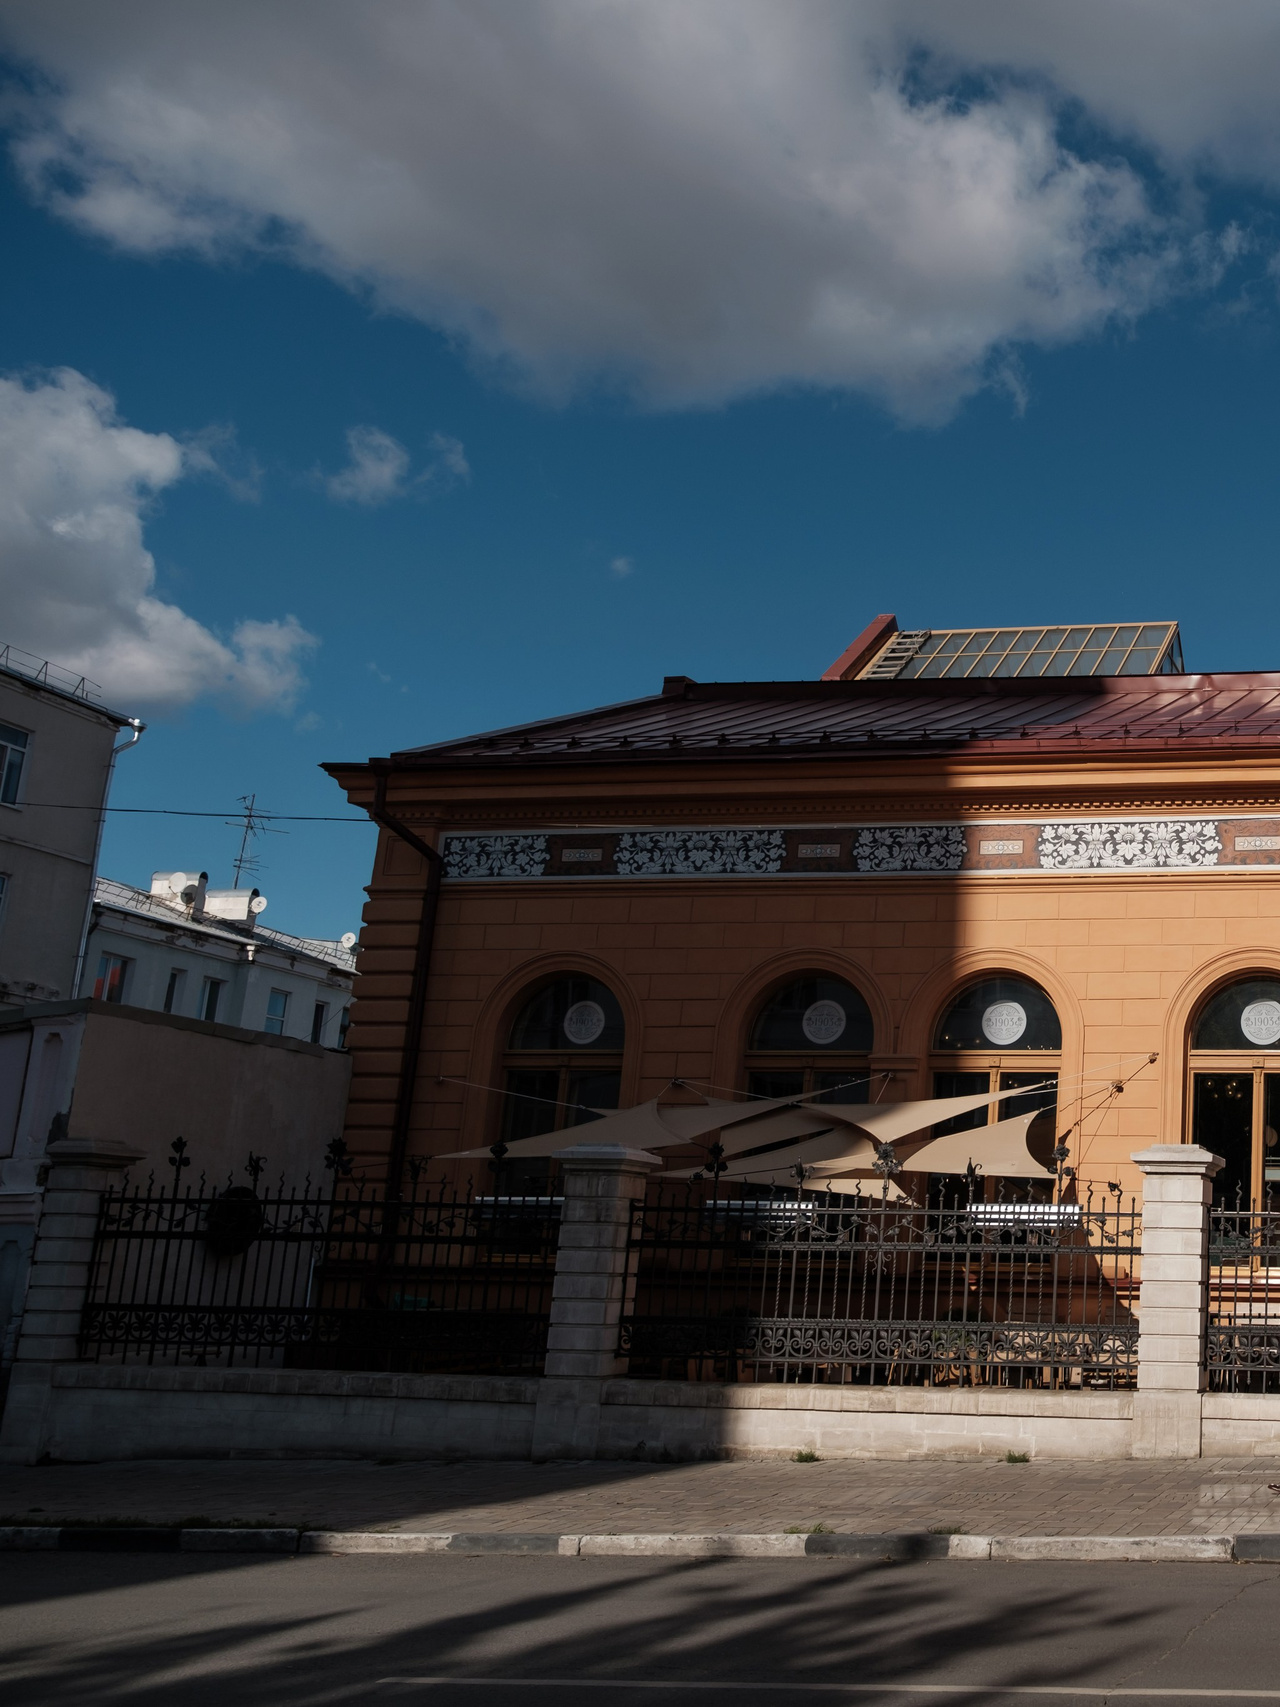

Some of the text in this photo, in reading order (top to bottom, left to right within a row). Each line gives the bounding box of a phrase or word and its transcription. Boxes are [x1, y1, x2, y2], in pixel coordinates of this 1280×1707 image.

[575, 1017, 594, 1027] 1903
[814, 1017, 834, 1027] 1903
[994, 1017, 1015, 1028] 1903
[1254, 1016, 1275, 1027] 1903
